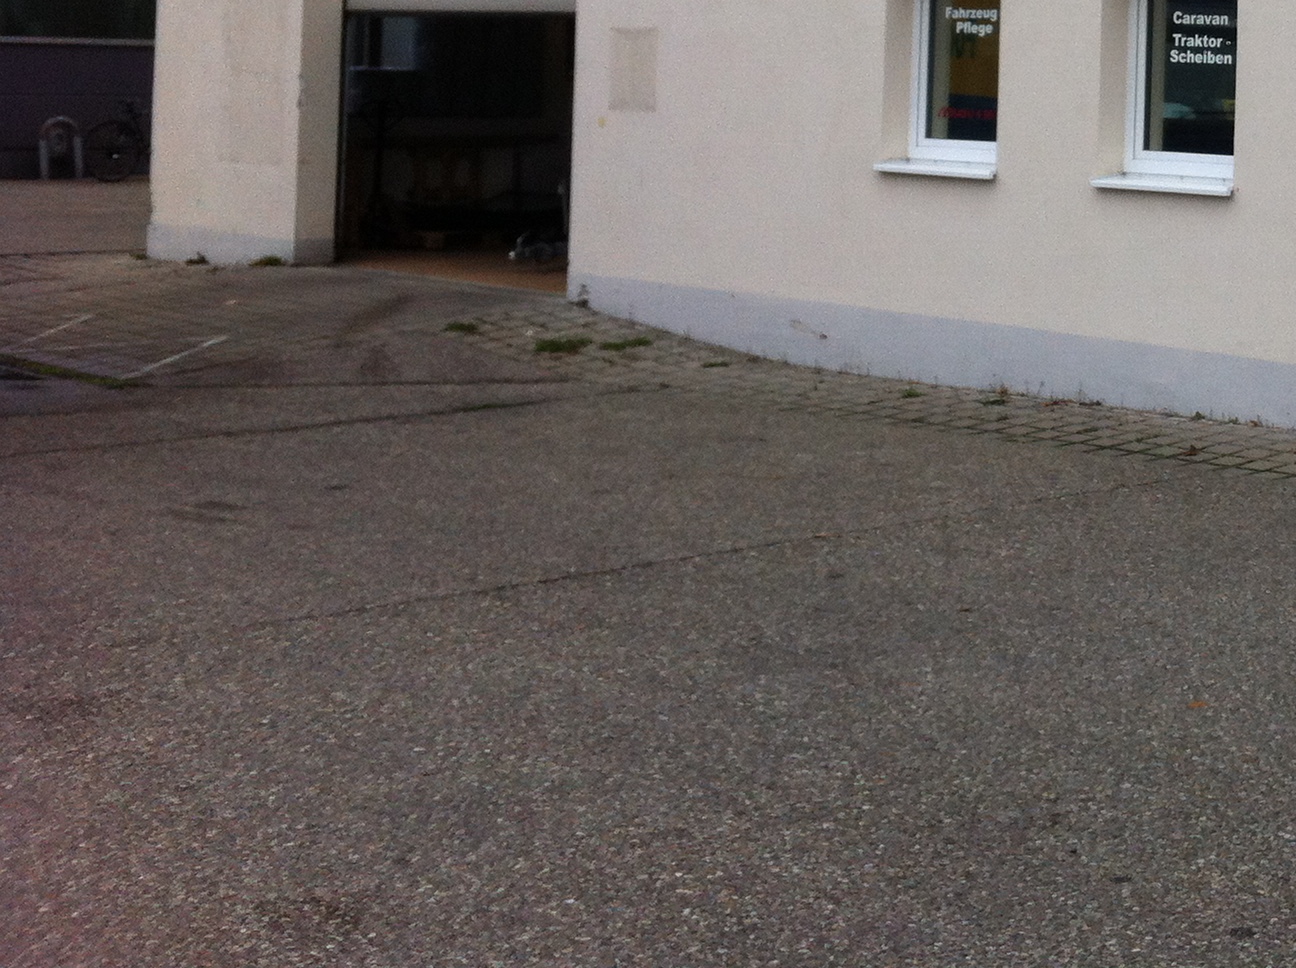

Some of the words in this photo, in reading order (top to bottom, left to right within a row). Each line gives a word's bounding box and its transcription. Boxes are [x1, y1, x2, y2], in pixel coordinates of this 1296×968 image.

[945, 6, 998, 22] Fahrzeug
[1173, 10, 1229, 26] Caravan
[956, 21, 993, 37] Pflege
[1170, 50, 1232, 65] Scheiben
